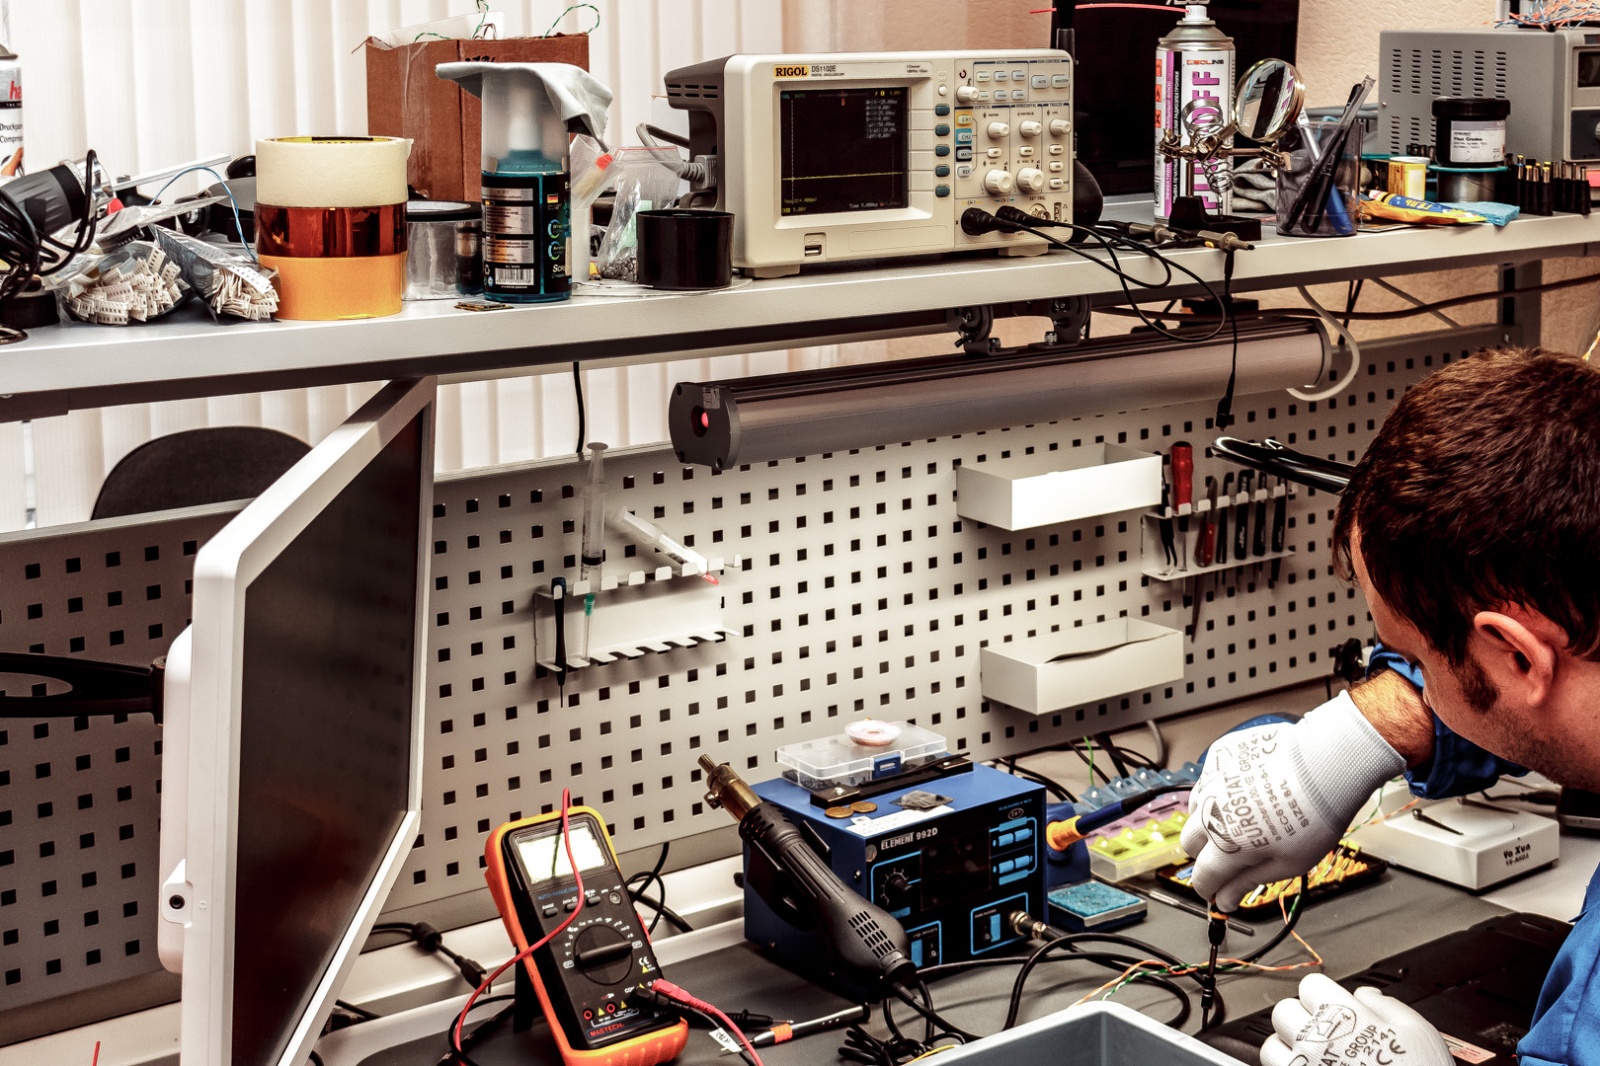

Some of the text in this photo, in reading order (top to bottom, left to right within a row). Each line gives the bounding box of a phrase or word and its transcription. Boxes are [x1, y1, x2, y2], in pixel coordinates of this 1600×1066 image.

[775, 67, 808, 77] RIGOL
[811, 65, 837, 73] DS1102E
[1250, 733, 1260, 761] 214
[1224, 774, 1269, 848] EUROSTAT
[1279, 778, 1309, 828] SIZE 8/L
[1222, 802, 1243, 837] EPA
[880, 827, 939, 850] ELEMENT 992D
[590, 1022, 625, 1038] MASTECH
[1344, 1024, 1377, 1058] GROUP
[1363, 1028, 1396, 1056] 2141
